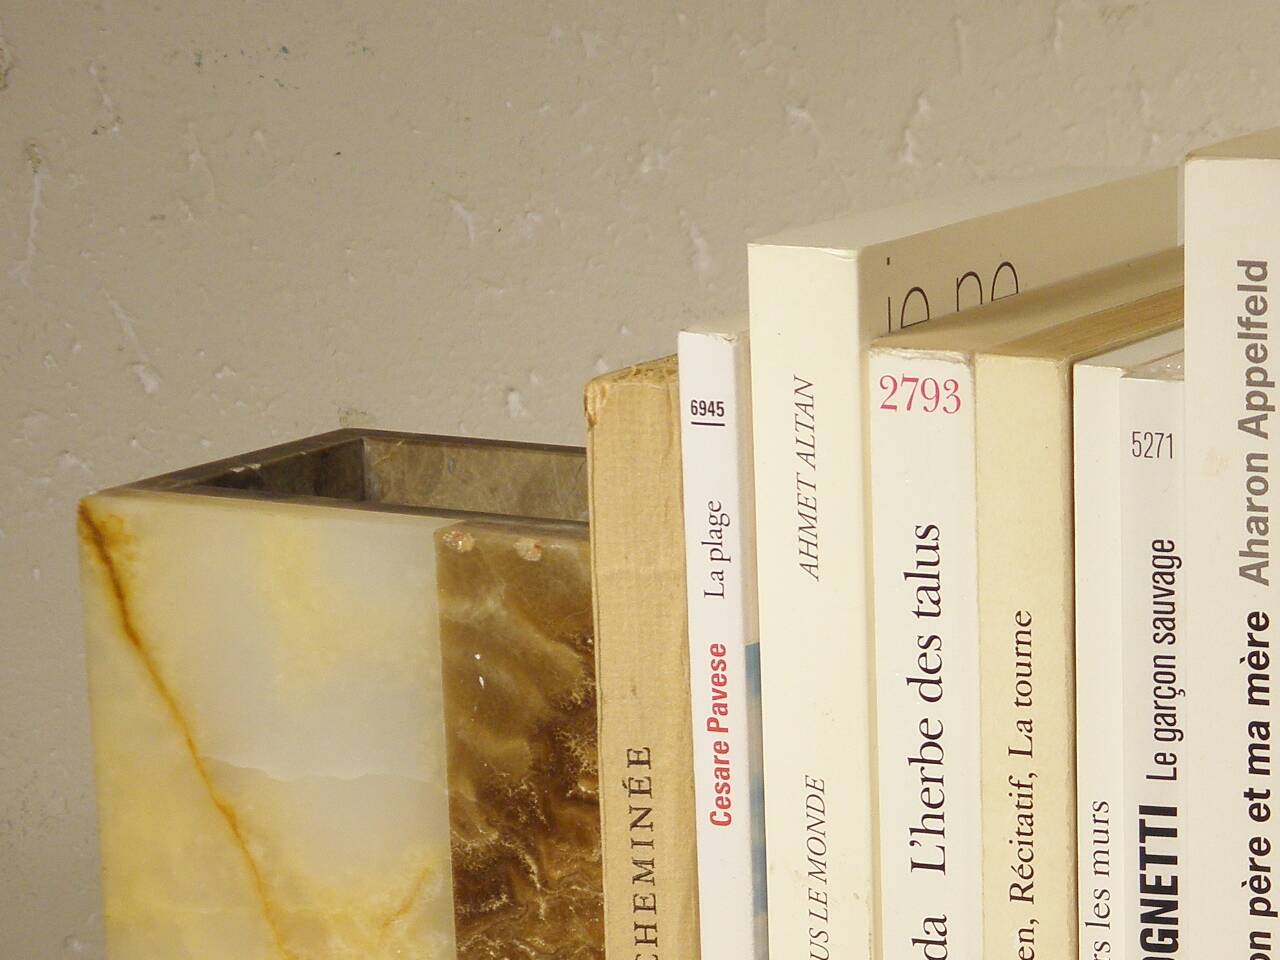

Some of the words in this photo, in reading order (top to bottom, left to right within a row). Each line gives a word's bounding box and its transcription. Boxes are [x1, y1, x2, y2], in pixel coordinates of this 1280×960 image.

[1236, 259, 1276, 440] Appelfeld
[690, 399, 725, 418] 6945
[793, 375, 816, 471] ALTAN
[879, 375, 961, 414] 2793
[1132, 431, 1173, 460] 5271
[706, 500, 732, 566] plage
[796, 471, 819, 581] AHMET
[1238, 452, 1270, 587] Aharon
[703, 569, 725, 599] La
[903, 524, 942, 619] talus
[1151, 539, 1183, 646] sauvage
[706, 643, 729, 733] Pavese
[905, 634, 943, 703] des
[1014, 610, 1033, 708] tourne
[1152, 654, 1186, 742] garçon
[1239, 611, 1270, 706] mère
[1007, 718, 1033, 759] La
[1145, 752, 1178, 781] Le
[1247, 720, 1271, 776] ma
[709, 740, 732, 827] Cesare
[1243, 787, 1271, 823] et
[805, 774, 827, 884] MONDE
[1008, 772, 1038, 905] Récitatif,
[1092, 801, 1110, 877] murs
[808, 887, 829, 923] LE
[1084, 888, 1111, 929] les
[1240, 836, 1279, 918] père
